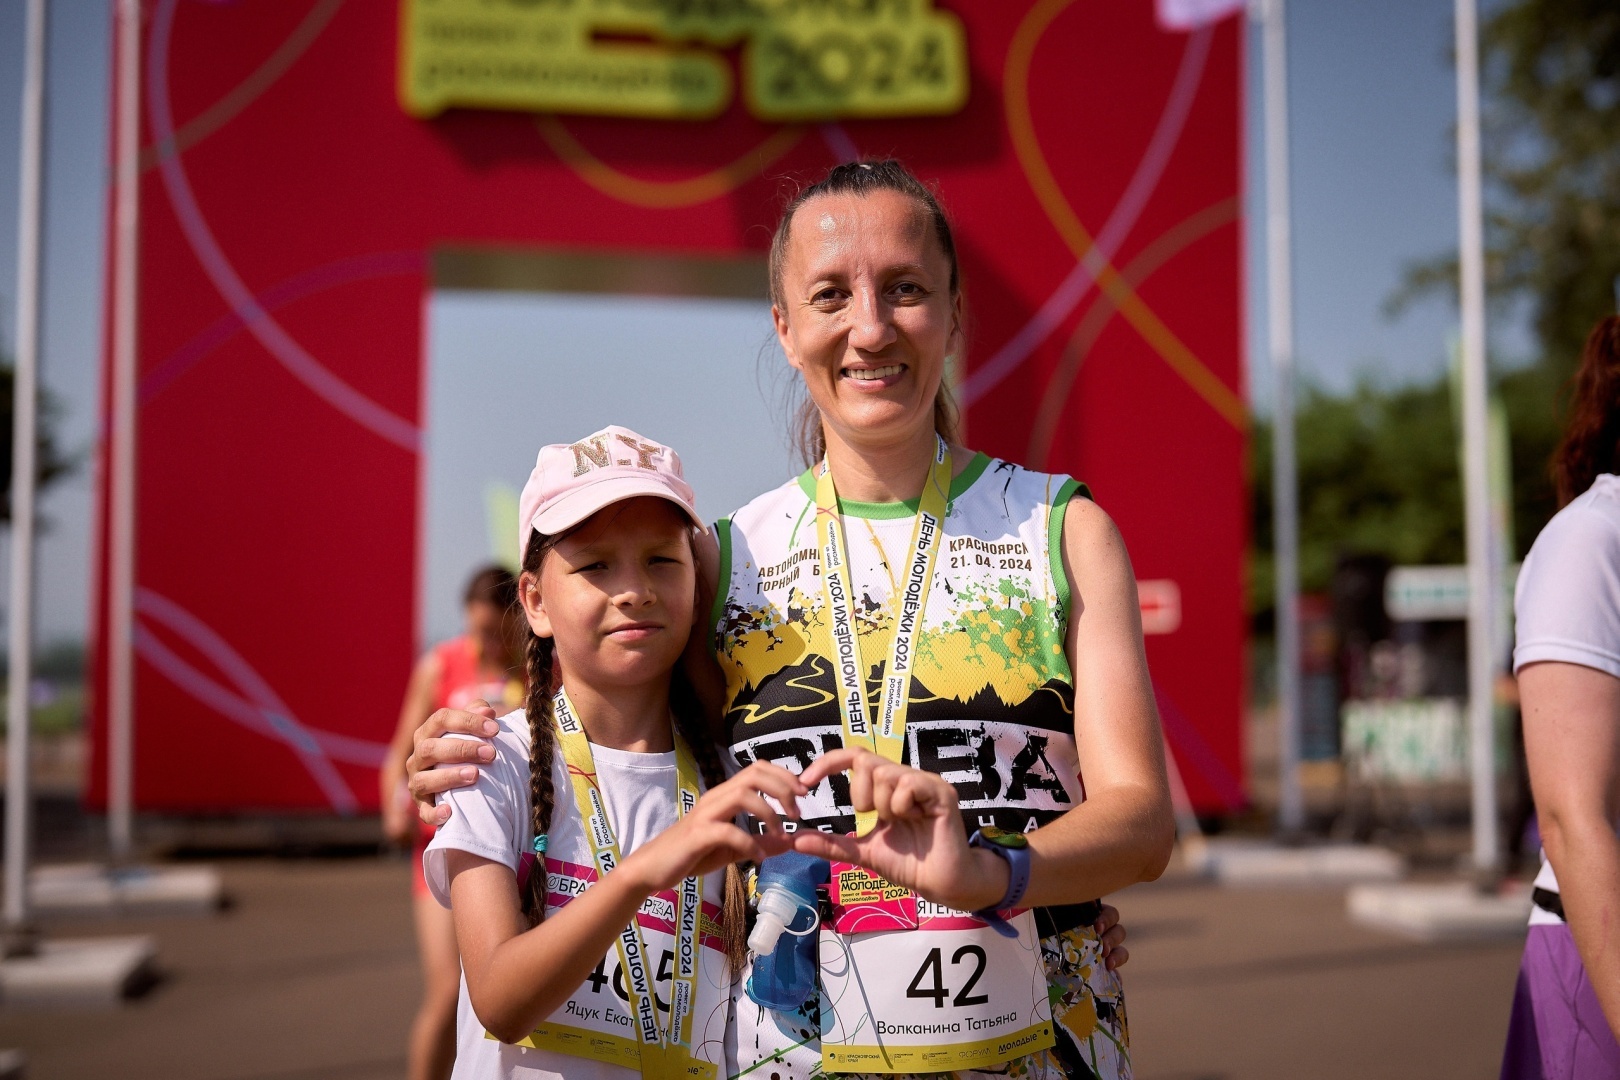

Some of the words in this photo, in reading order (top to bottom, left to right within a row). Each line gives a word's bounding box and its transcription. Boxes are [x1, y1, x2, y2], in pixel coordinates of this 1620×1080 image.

[918, 513, 936, 551] ДЕНЬ
[756, 566, 800, 595] ГОРНЫЙ
[999, 558, 1032, 572] 2024
[828, 572, 844, 602] 2024
[900, 552, 929, 633] МОЛОДЁЖИ
[833, 605, 858, 688] МОЛОДЁЖИ
[894, 637, 909, 671] 2024
[556, 698, 579, 733] ДЕНЬ
[847, 691, 867, 734] ДЕНЬ
[841, 871, 869, 883] ДЕНЬ
[884, 888, 910, 900] 2024
[681, 936, 692, 975] 2024
[906, 944, 989, 1008] 42
[565, 1000, 600, 1020] Яцук
[639, 996, 659, 1042] ДЕНЬ
[877, 1020, 961, 1036] Волканина
[964, 1011, 1017, 1031] Татьяна
